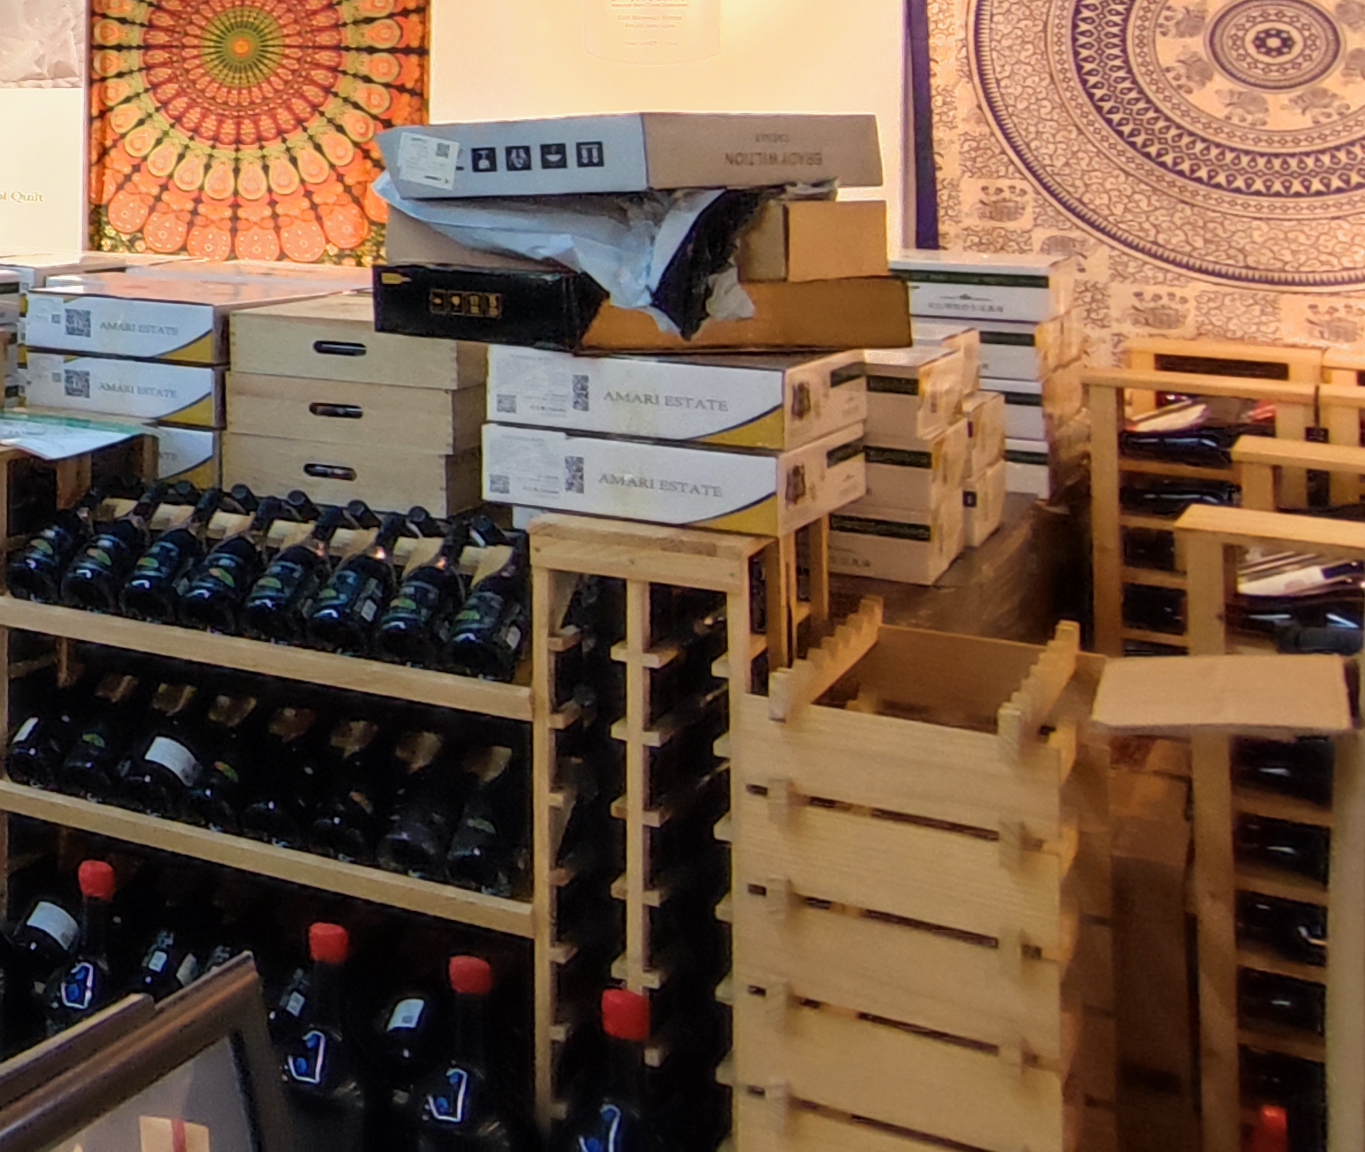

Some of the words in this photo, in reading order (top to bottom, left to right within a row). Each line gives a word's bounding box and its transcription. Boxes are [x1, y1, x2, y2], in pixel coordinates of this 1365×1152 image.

[10, 190, 44, 204] Quilt
[99, 321, 136, 333] AMARI
[138, 323, 179, 336] ESTATE
[98, 382, 135, 395] AMARI
[137, 385, 178, 398] ESTATE
[603, 390, 660, 407] AMARI
[664, 394, 729, 413] ESTATE
[598, 472, 655, 490] AMARI
[659, 478, 724, 498] ESTATE
